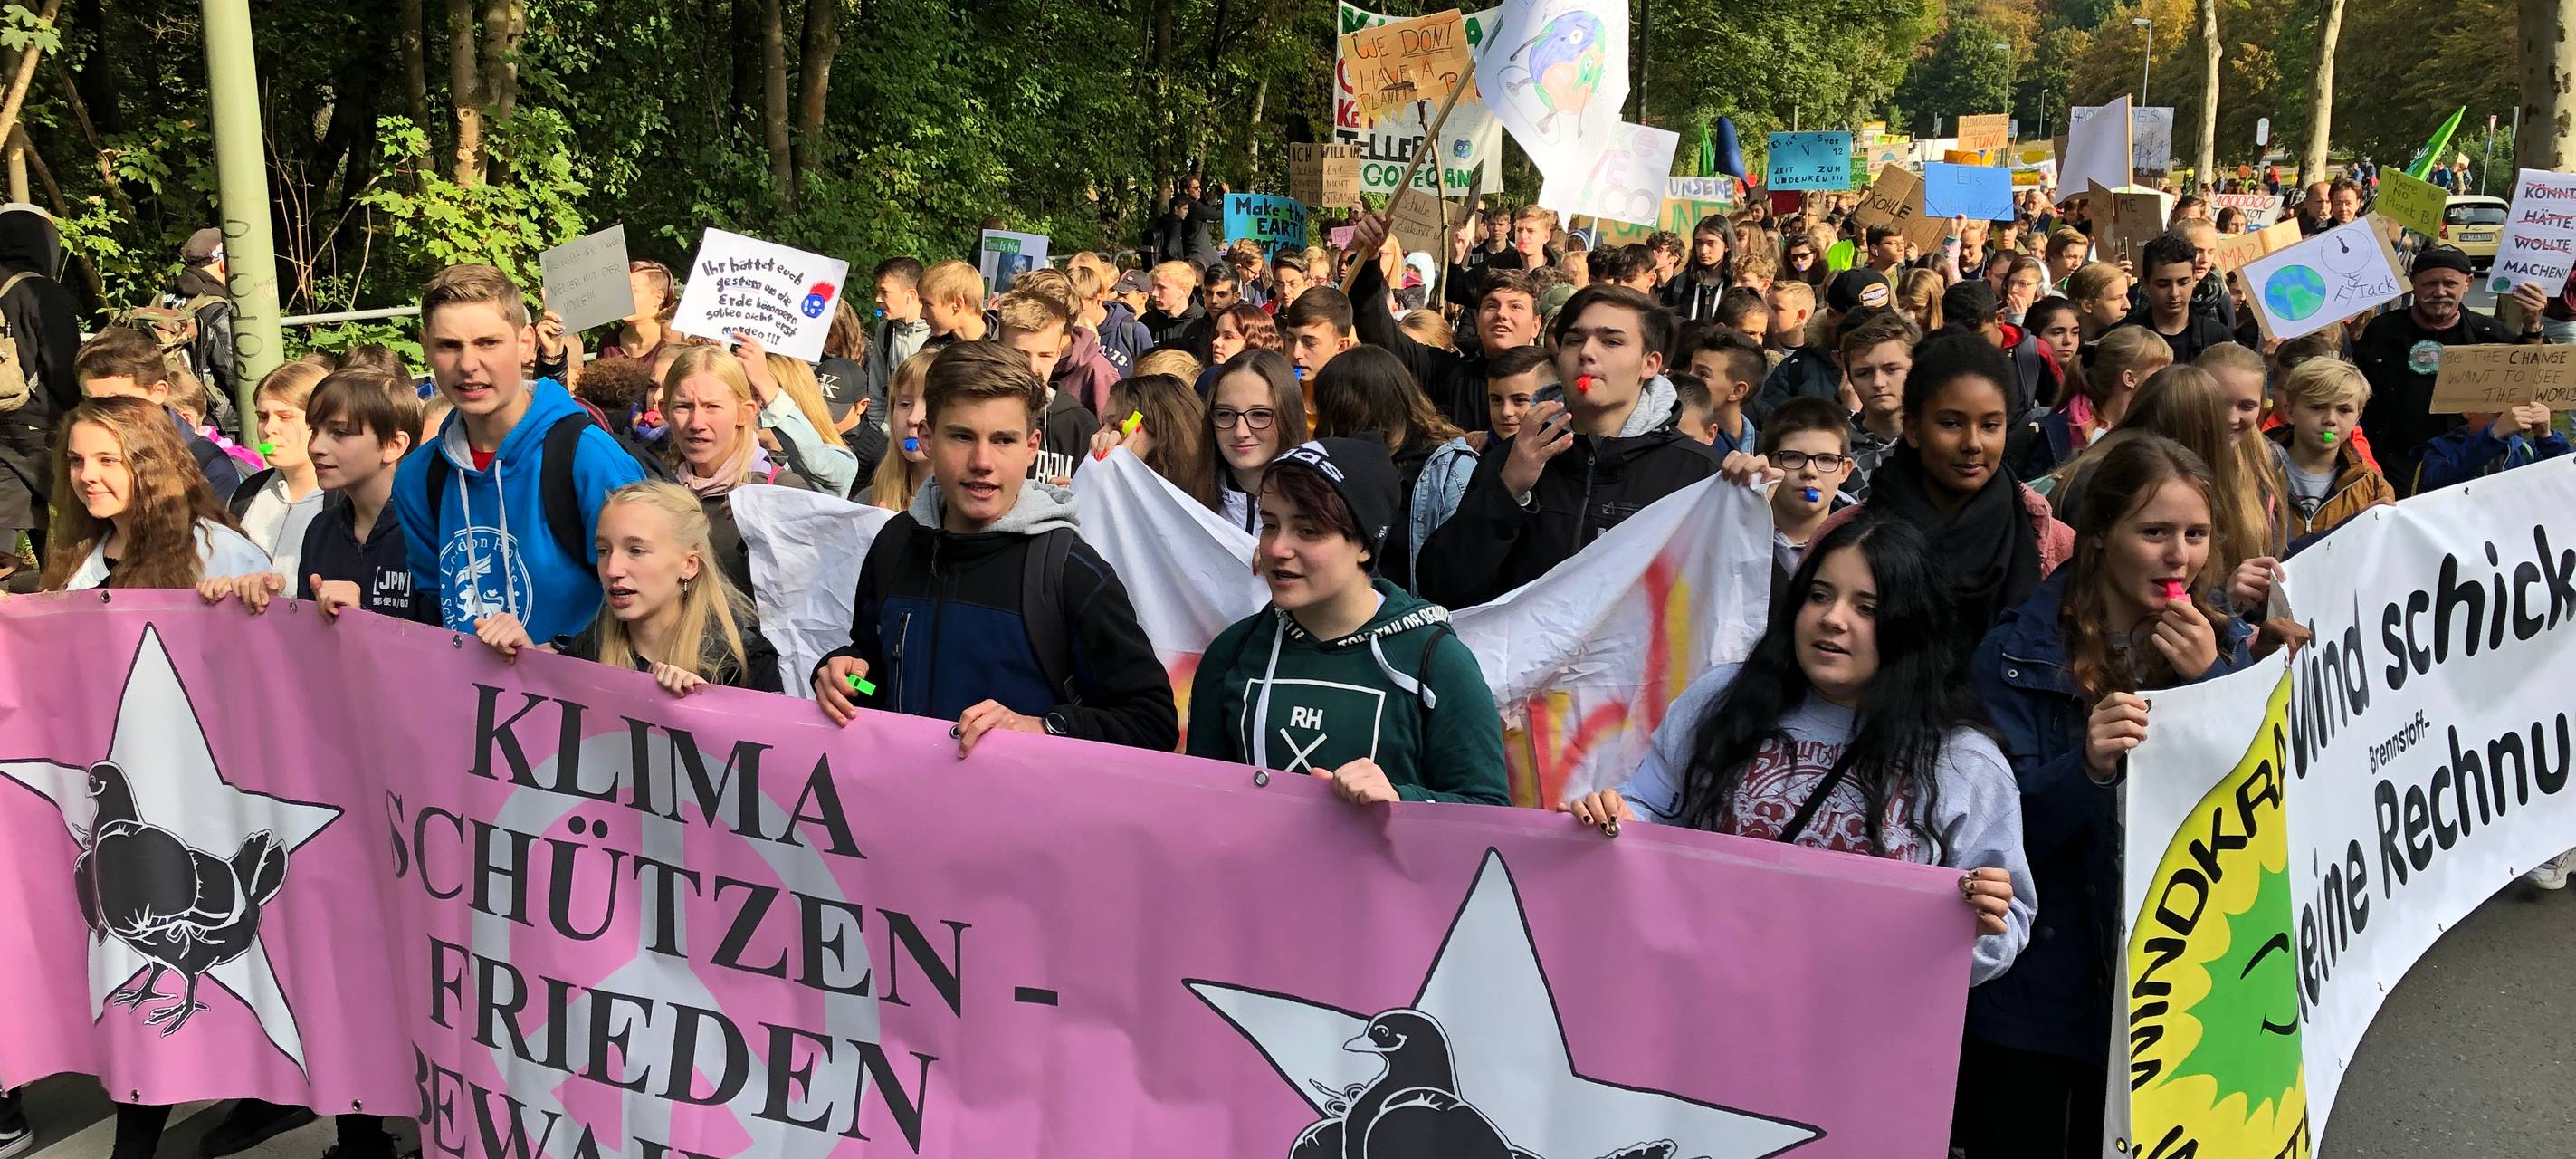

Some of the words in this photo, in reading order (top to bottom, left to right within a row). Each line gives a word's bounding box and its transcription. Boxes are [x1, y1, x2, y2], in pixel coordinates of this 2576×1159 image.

[1353, 33, 1390, 60] WE
[1398, 23, 1453, 54] DON'T
[1360, 64, 1407, 91] HAVE
[1421, 58, 1435, 80] A
[1293, 147, 1312, 162] ICH
[1320, 147, 1346, 158] WILL
[1771, 139, 1781, 148] ES
[1669, 177, 1732, 199] UNSERE
[2524, 184, 2576, 200] KÖNNT
[1236, 197, 1280, 216] Make
[1286, 203, 1304, 225] the
[2385, 195, 2415, 218] Planet
[1257, 218, 1303, 242] EARTH
[2514, 237, 2572, 251] WOLLTE.
[702, 260, 725, 276] Ihr
[730, 257, 775, 273] hättet
[777, 264, 805, 286] euch
[2504, 260, 2568, 280] MACHEN!
[718, 293, 753, 307] Erde
[778, 291, 792, 308] die
[2509, 350, 2569, 365] CHANGE
[2504, 369, 2525, 383] TO
[2535, 369, 2563, 385] SEE
[2483, 387, 2520, 404] THE
[2381, 524, 2576, 691] schick
[1290, 705, 1323, 730] RH
[2369, 709, 2431, 776] Brennstoff-
[469, 683, 867, 859] KLIMA
[2295, 839, 2370, 1025] eine
[2373, 712, 2576, 900] Rechnu
[386, 789, 971, 1017] SCHÜTZEN
[2131, 715, 2288, 1093] WINDKRA
[428, 935, 939, 1154] FRIEDEN
